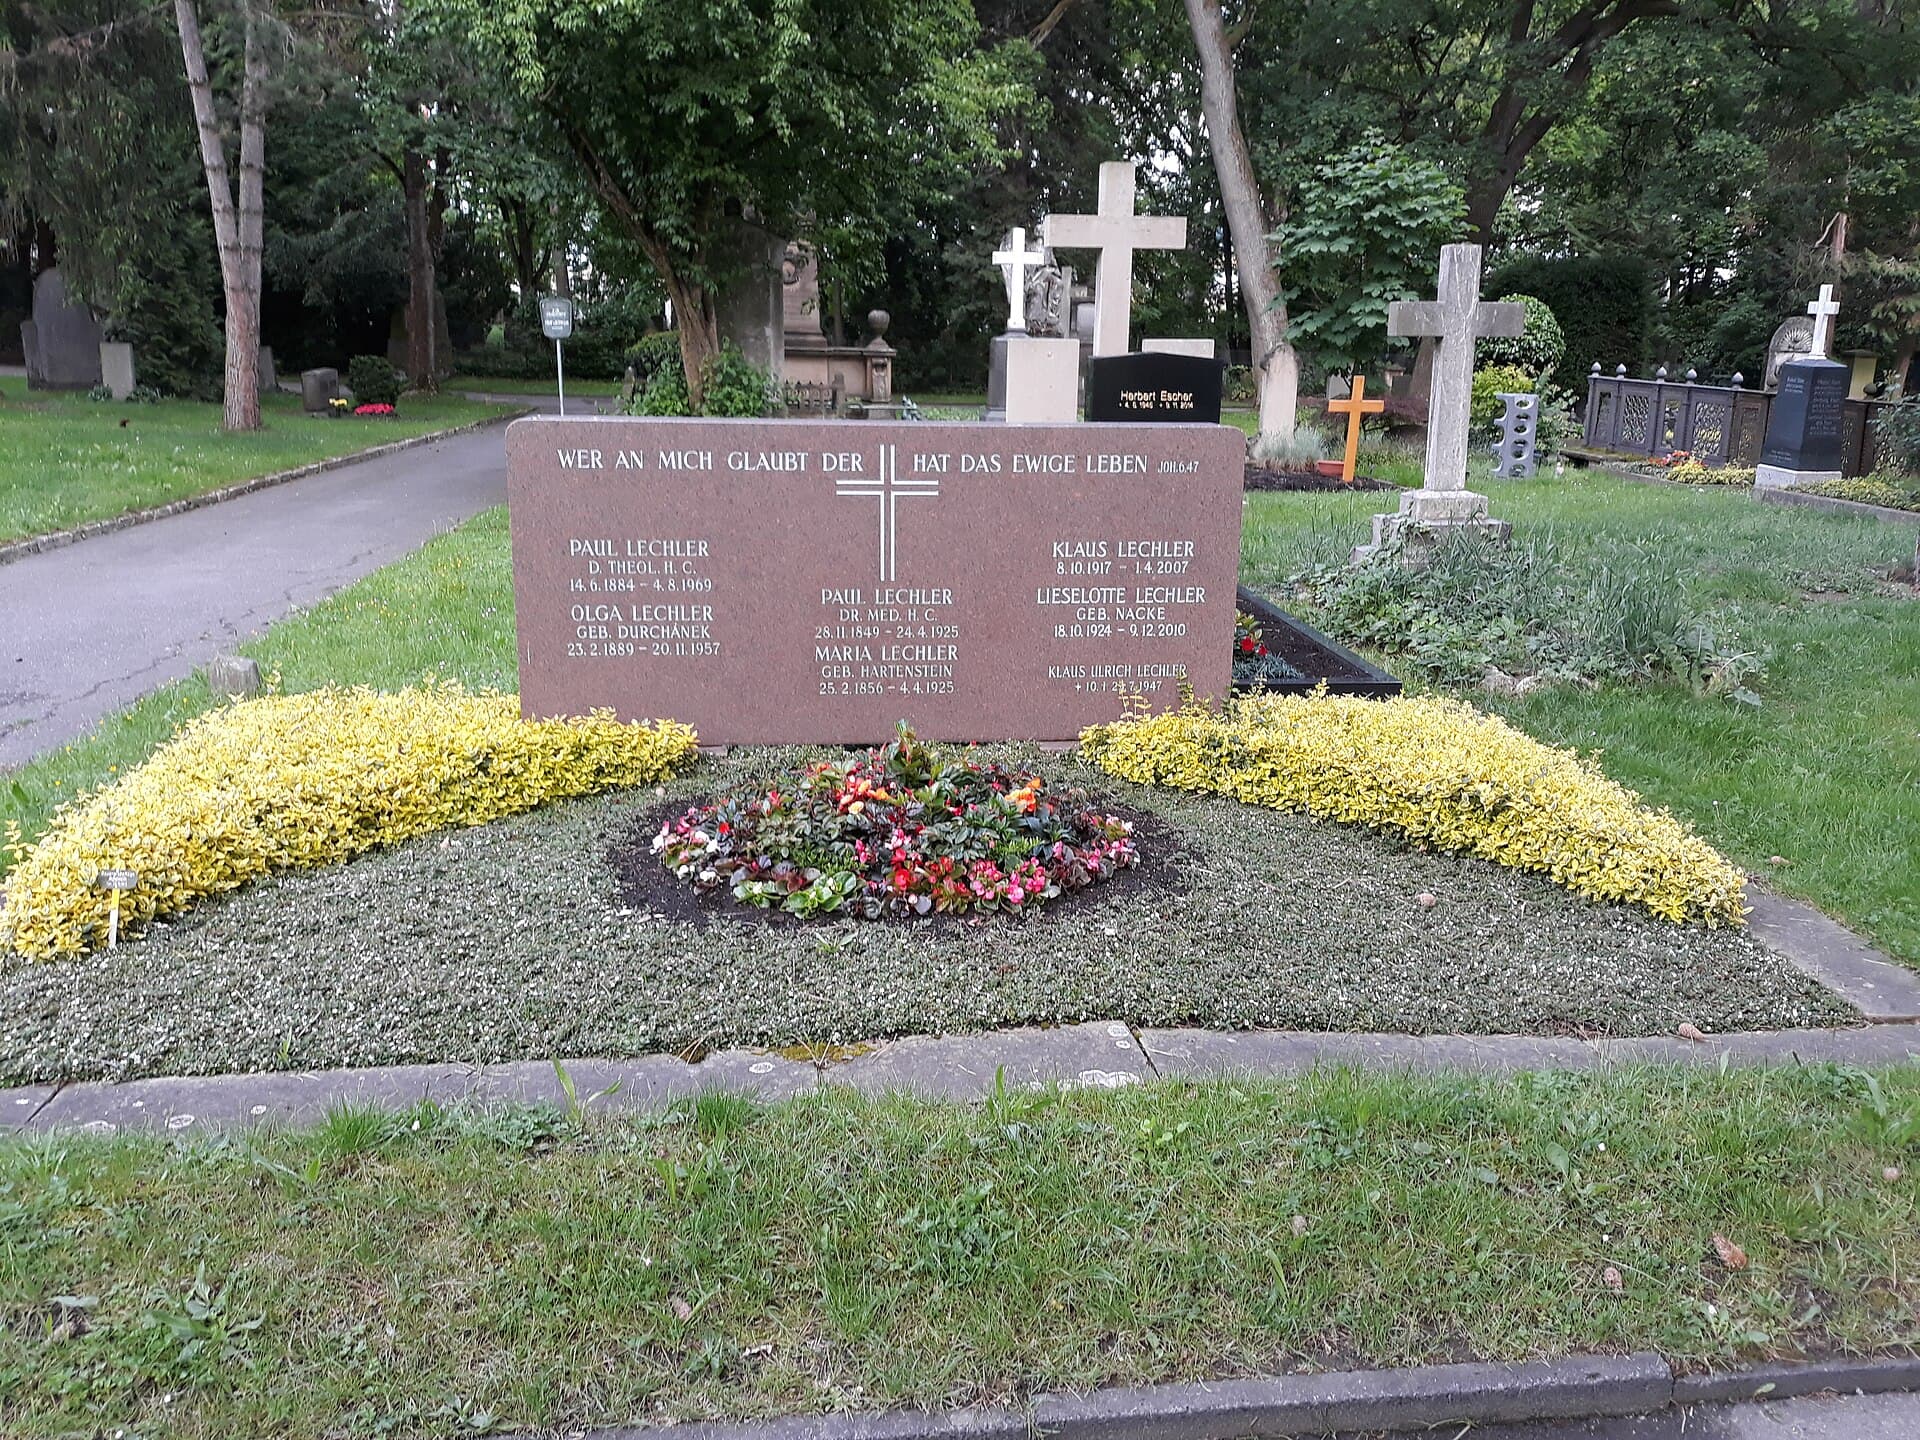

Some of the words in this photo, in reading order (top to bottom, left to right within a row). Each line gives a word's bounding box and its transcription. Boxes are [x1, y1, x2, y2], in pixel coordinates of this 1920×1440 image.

[1121, 389, 1155, 401] Herbert
[1160, 390, 1193, 402] Escher
[557, 449, 604, 469] WER
[615, 450, 644, 469] AN
[658, 451, 713, 470] MICH
[727, 452, 809, 472] GLAUBT
[822, 453, 864, 472] DER
[913, 454, 951, 473] HAT
[960, 454, 1002, 473] DAS
[1012, 455, 1076, 473] EWIGE
[1086, 455, 1148, 473] LEBEN
[569, 539, 618, 557] PAUL
[627, 540, 709, 557] LECHLER
[1052, 541, 1108, 558] KLAUS
[1117, 541, 1194, 558] LECHLER
[588, 560, 602, 575] D.
[607, 560, 661, 575] THEOL.
[664, 560, 677, 575] H.
[682, 560, 697, 575] C.
[821, 588, 866, 605] PAUL
[875, 588, 953, 605] LECHLER
[1036, 587, 1126, 605] LIESELOTTE
[1135, 586, 1206, 604] LECHLER
[571, 604, 623, 622] OLGA
[632, 604, 714, 622] LECHLER
[839, 608, 863, 622] DR.
[867, 608, 902, 622] MED.
[908, 609, 920, 622] H.
[924, 608, 938, 622] C.
[1076, 607, 1111, 621] GEB.
[1116, 607, 1166, 621] NACKE
[576, 625, 612, 639] GEB.
[815, 645, 873, 662] MARIA
[881, 644, 958, 661] LECHLER
[821, 665, 855, 679] GEB.
[861, 664, 953, 679] HARTENSTEIN
[1048, 665, 1086, 679] KLAUS
[1090, 664, 1132, 678] ULRICH
[1137, 663, 1188, 678] LECHLER
